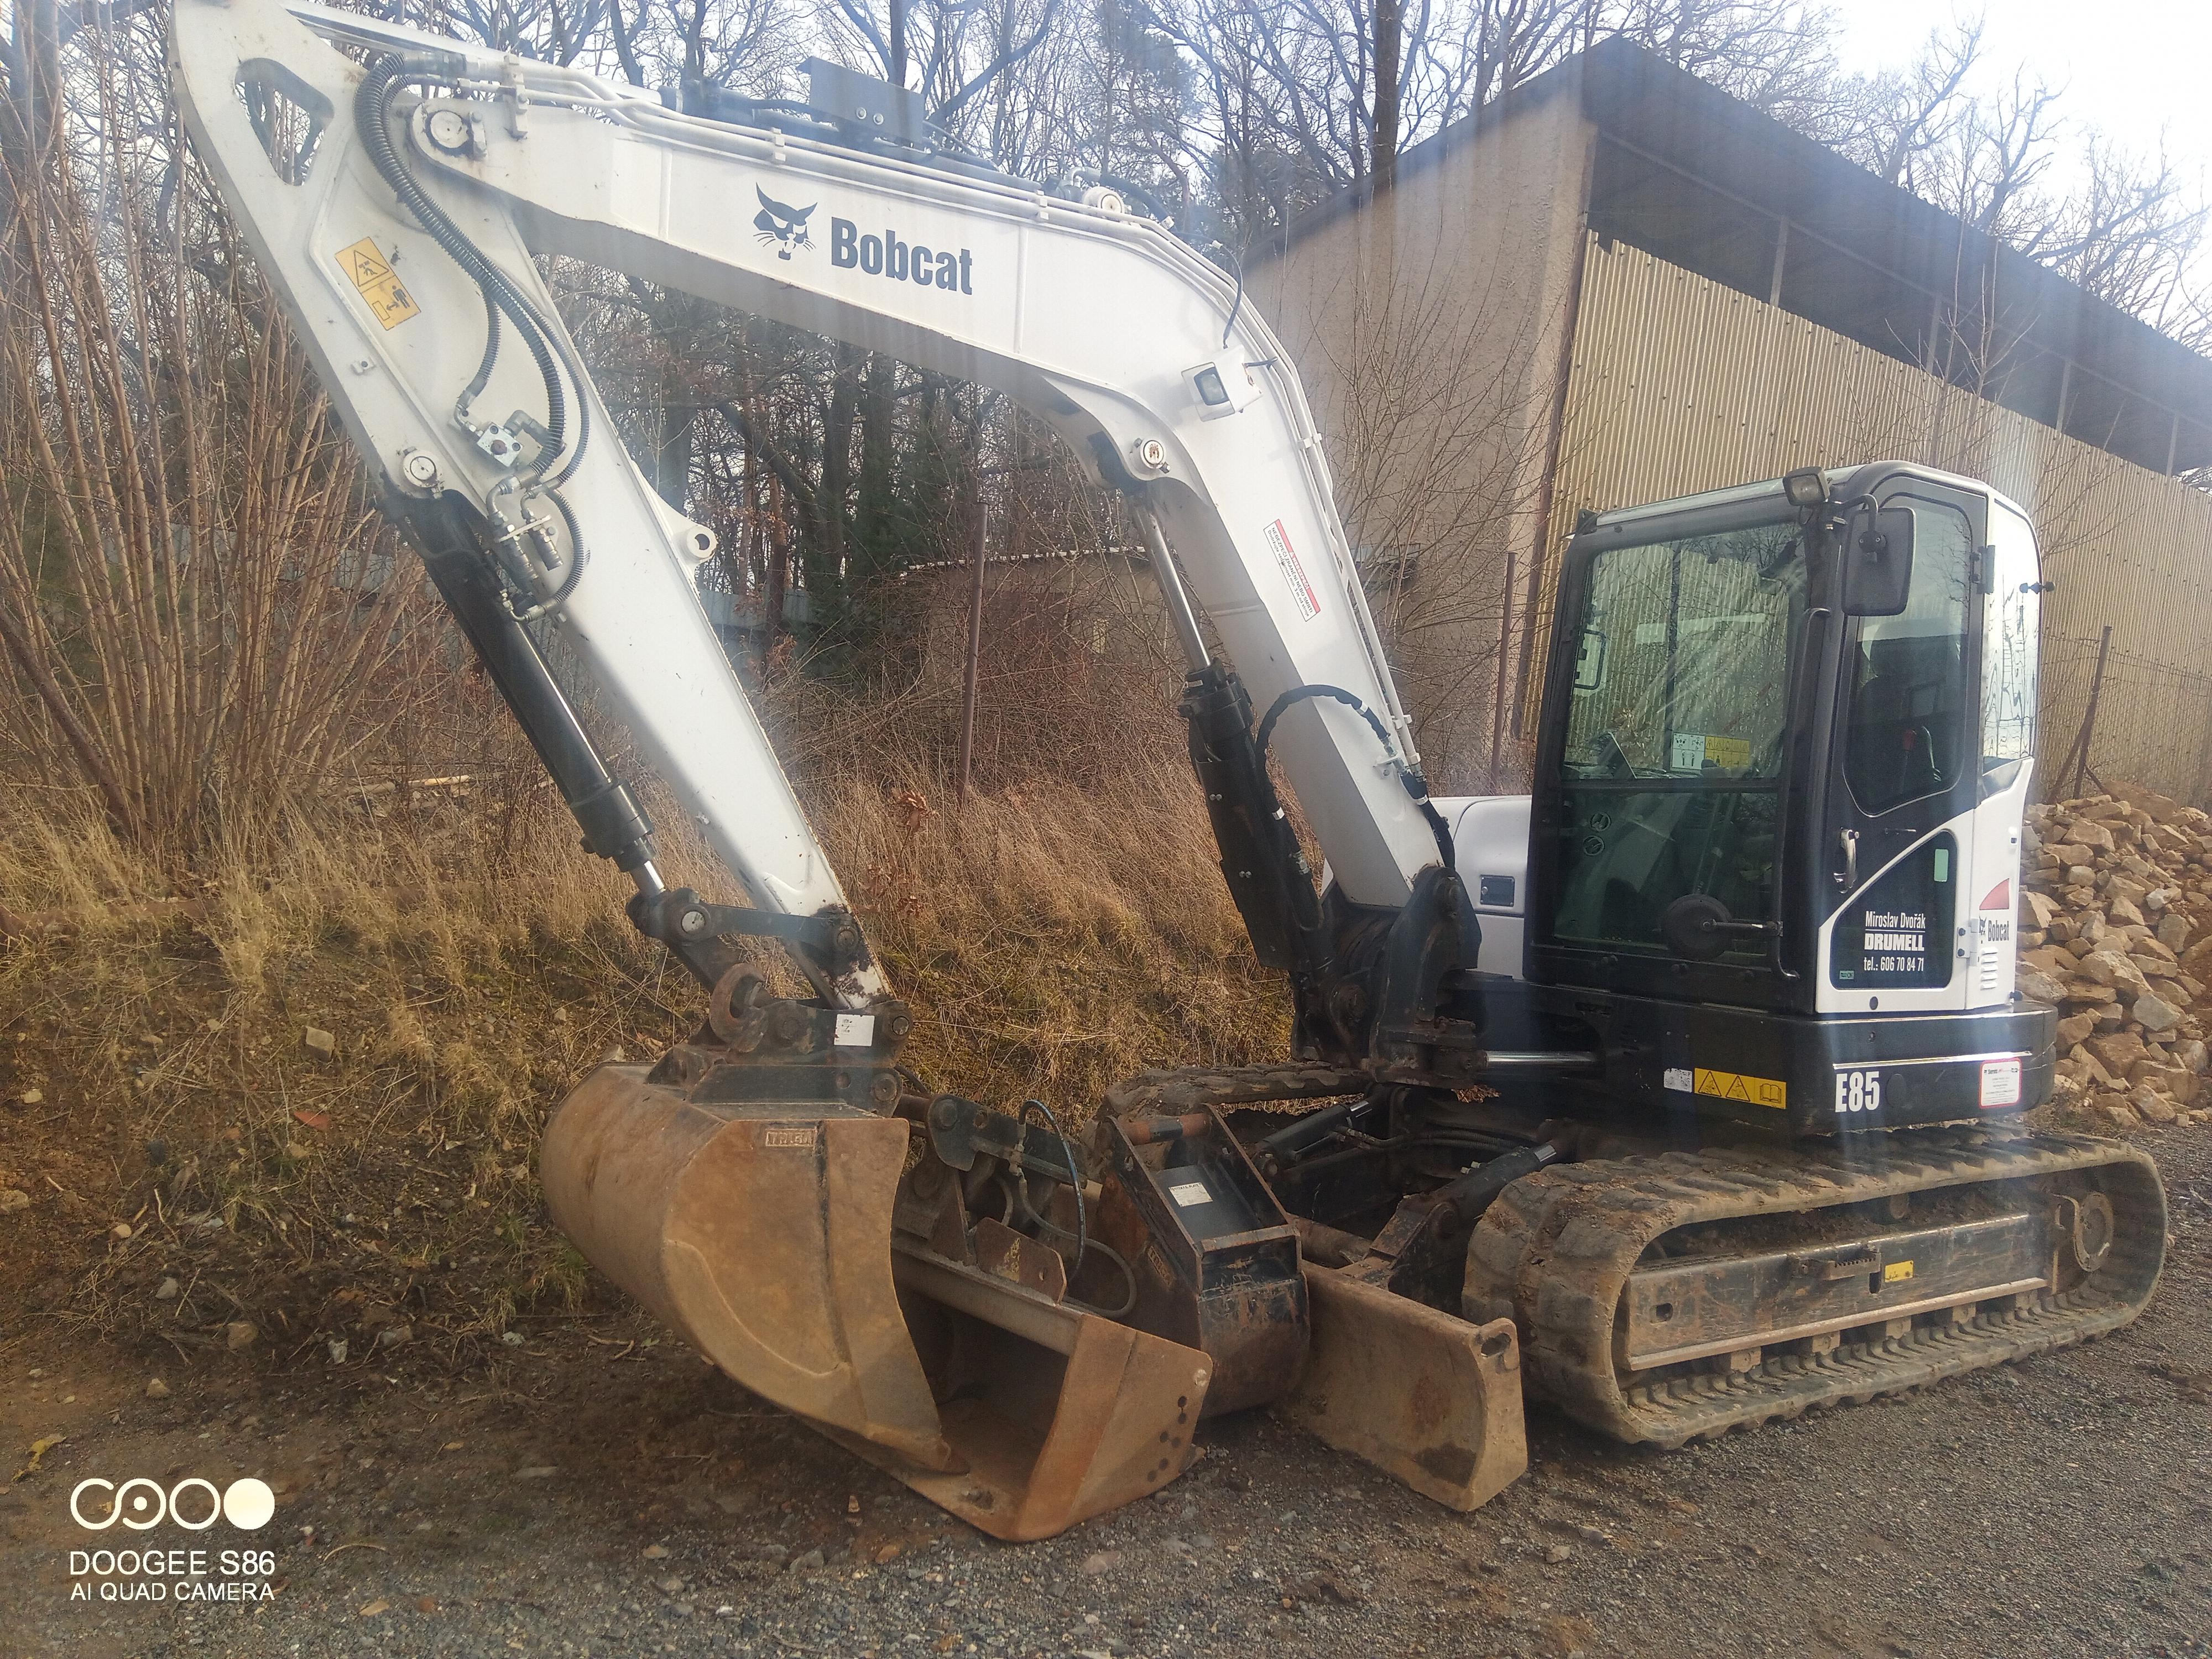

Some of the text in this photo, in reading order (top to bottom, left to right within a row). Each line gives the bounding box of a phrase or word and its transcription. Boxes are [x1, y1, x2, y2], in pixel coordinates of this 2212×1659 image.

[831, 217, 972, 295] Bobcat
[1296, 581, 1305, 596] NEBO
[1303, 597, 1313, 613] SMRTI
[1865, 911, 1926, 928] Miroslav Dvořák
[1988, 920, 2009, 941] Bobcat
[1864, 933, 1924, 951] DRUMELL
[1864, 957, 1924, 971] tel.: 606 70 84 71
[1836, 1071, 1880, 1112] E85
